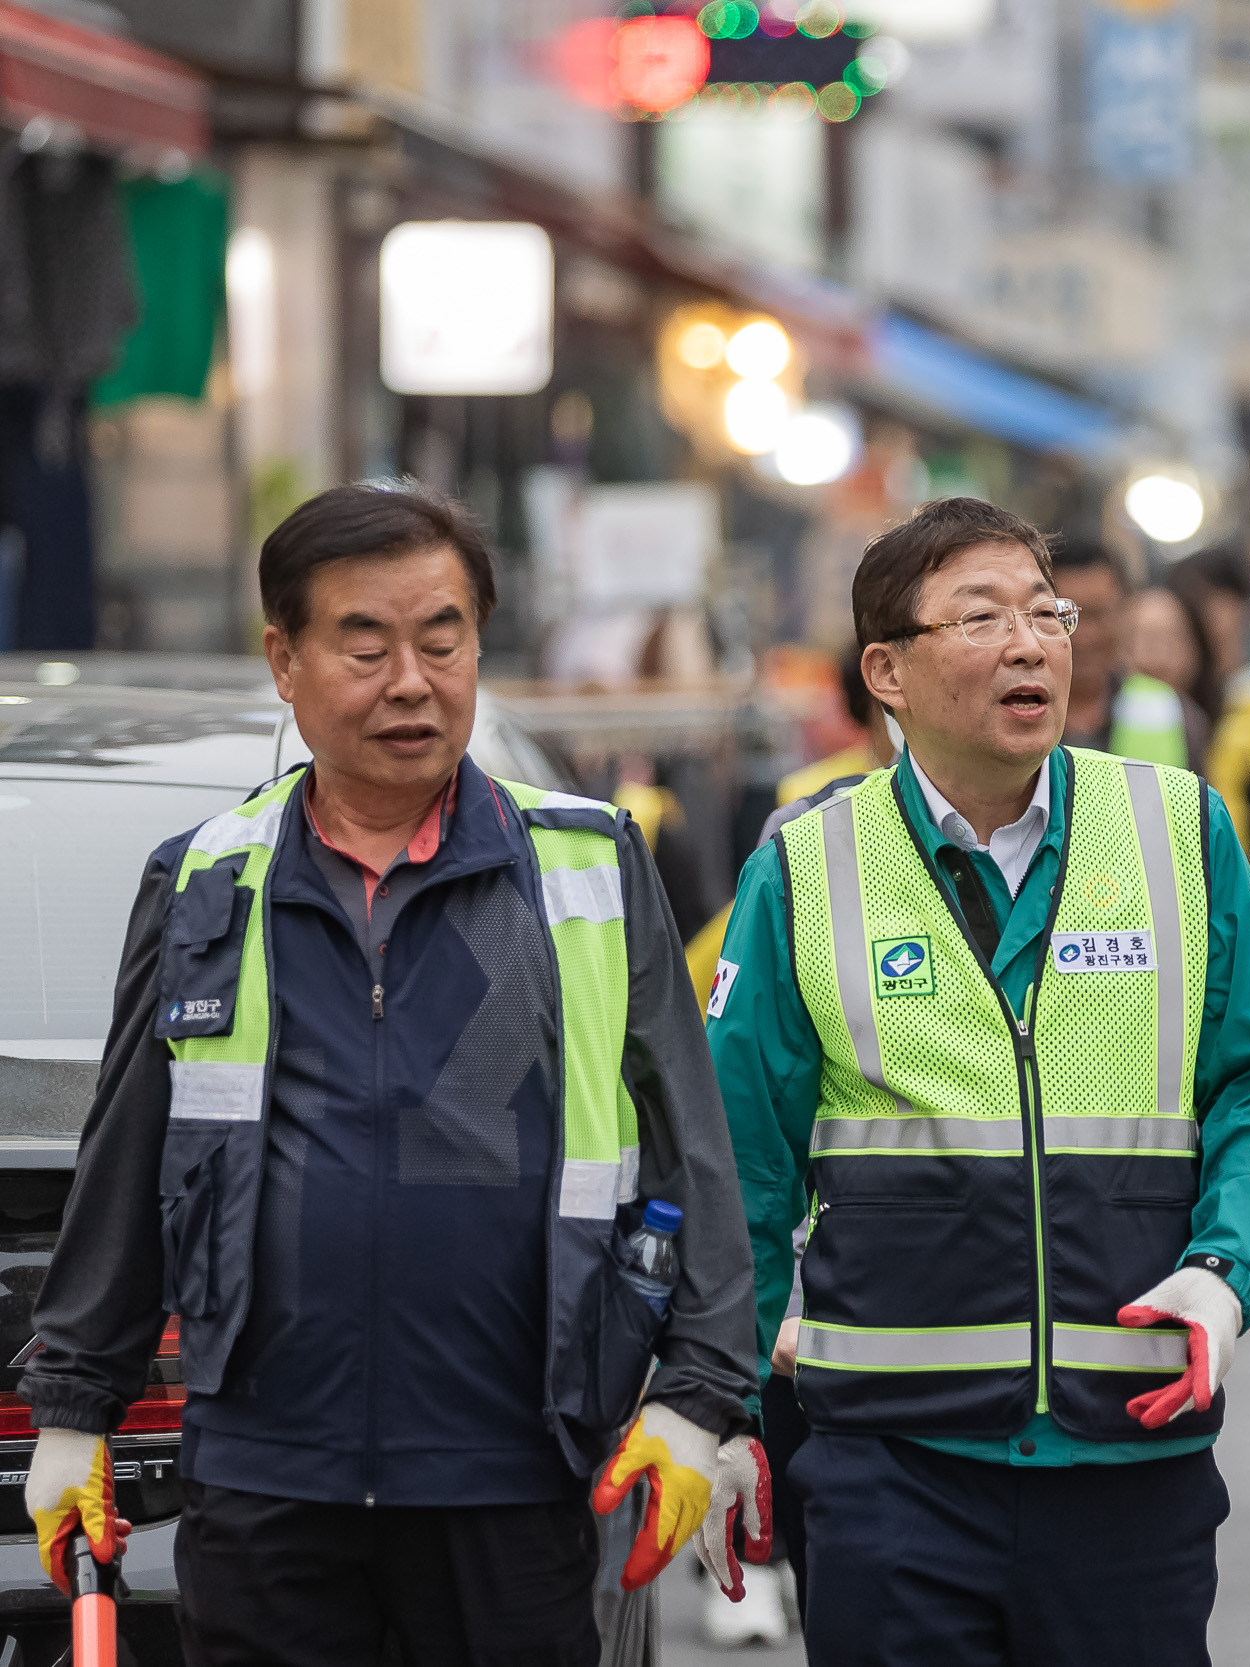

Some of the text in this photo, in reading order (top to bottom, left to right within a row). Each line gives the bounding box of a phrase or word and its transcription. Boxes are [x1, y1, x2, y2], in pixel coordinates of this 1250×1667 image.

[1084, 953, 1148, 967] 광진구청장
[881, 977, 929, 991] 광진구
[183, 998, 222, 1014] 광진구
